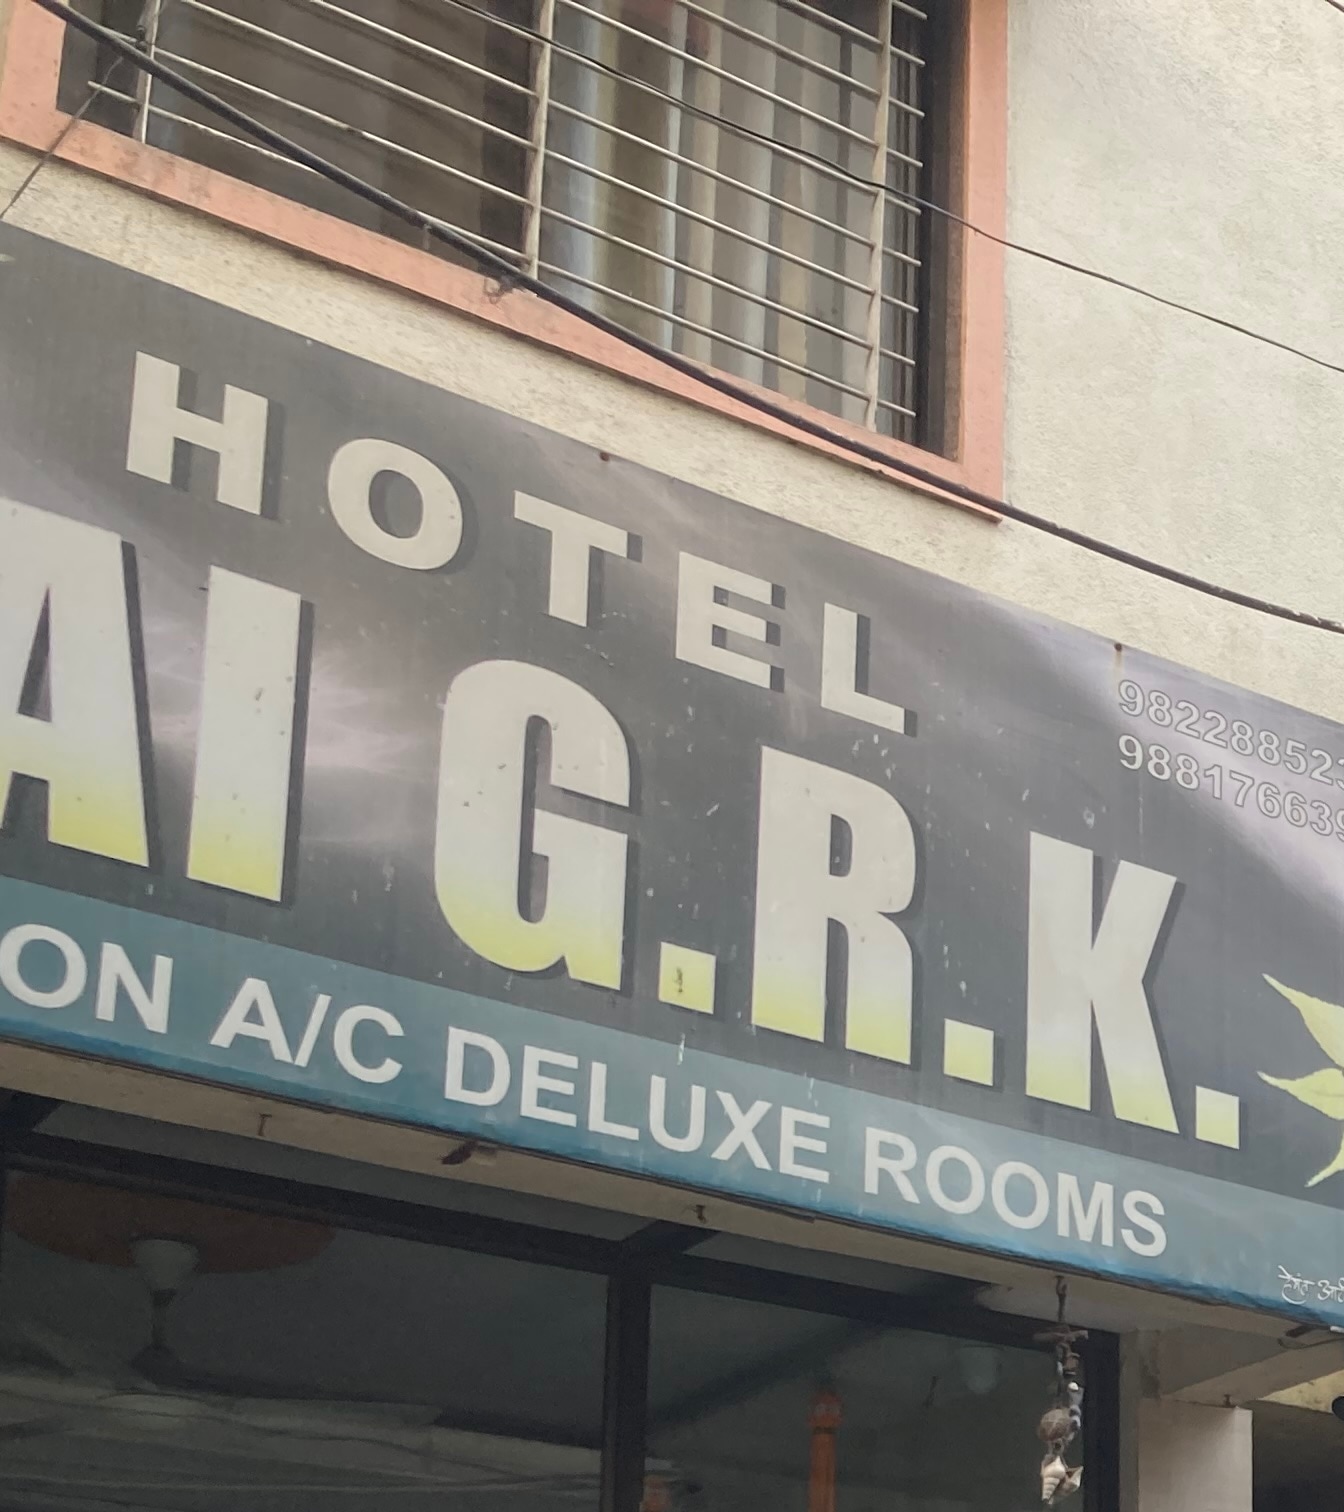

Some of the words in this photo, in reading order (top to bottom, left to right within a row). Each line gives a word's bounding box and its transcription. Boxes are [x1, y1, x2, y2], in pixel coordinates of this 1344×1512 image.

[127, 351, 914, 734] HOTEL
[0, 500, 301, 902] AI
[434, 660, 1240, 1149] G.R.K.
[0, 924, 173, 1033] ON
[210, 977, 405, 1084] A/C
[444, 1026, 831, 1184] DELUXE
[864, 1126, 1168, 1258] ROOMS
